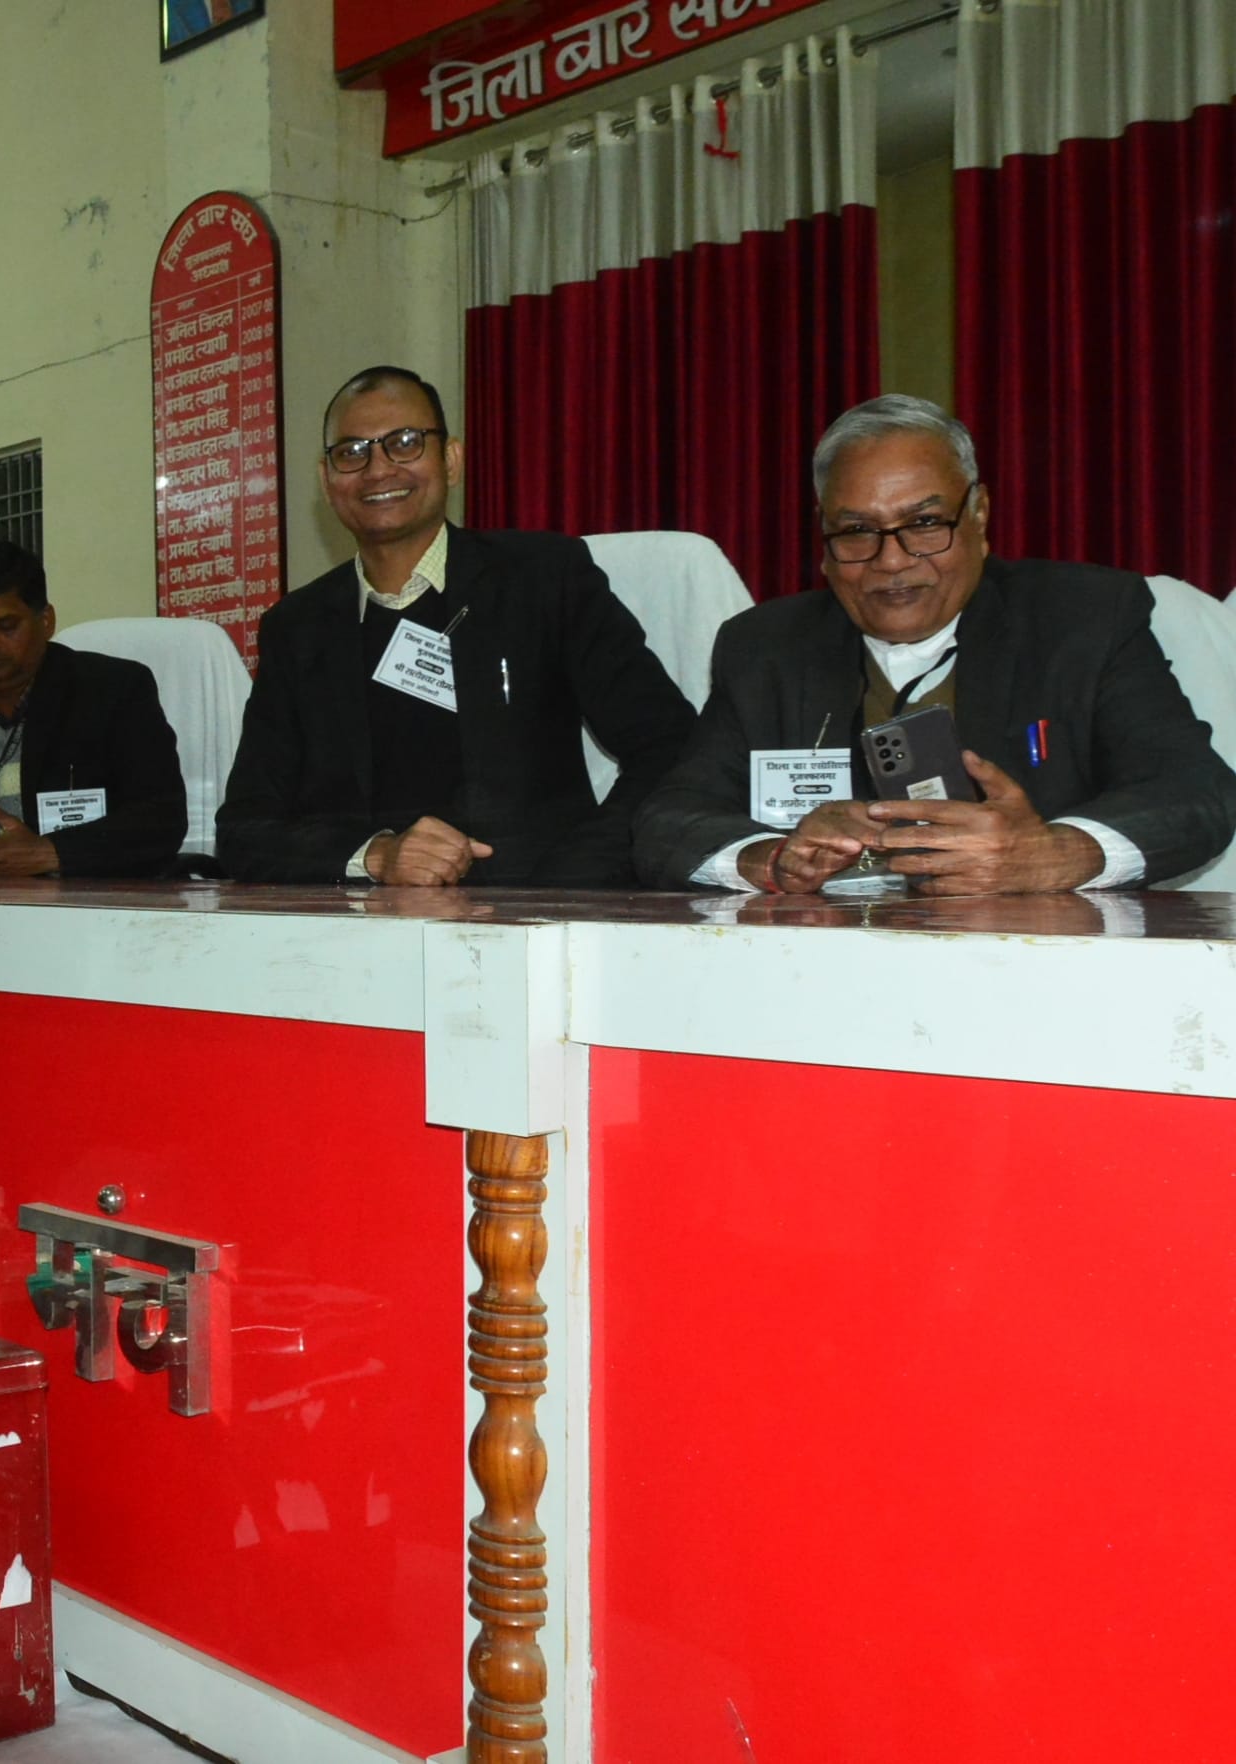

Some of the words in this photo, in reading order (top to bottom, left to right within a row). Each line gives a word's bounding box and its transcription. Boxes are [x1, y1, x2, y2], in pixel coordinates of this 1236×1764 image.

[421, 40, 545, 131] जिला
[552, 1, 651, 80] बार
[668, 0, 771, 40] स
[161, 217, 196, 272] जिला
[195, 204, 229, 227] बार
[231, 207, 258, 247] संघ
[766, 761, 789, 771] जिला
[793, 762, 806, 770] बार
